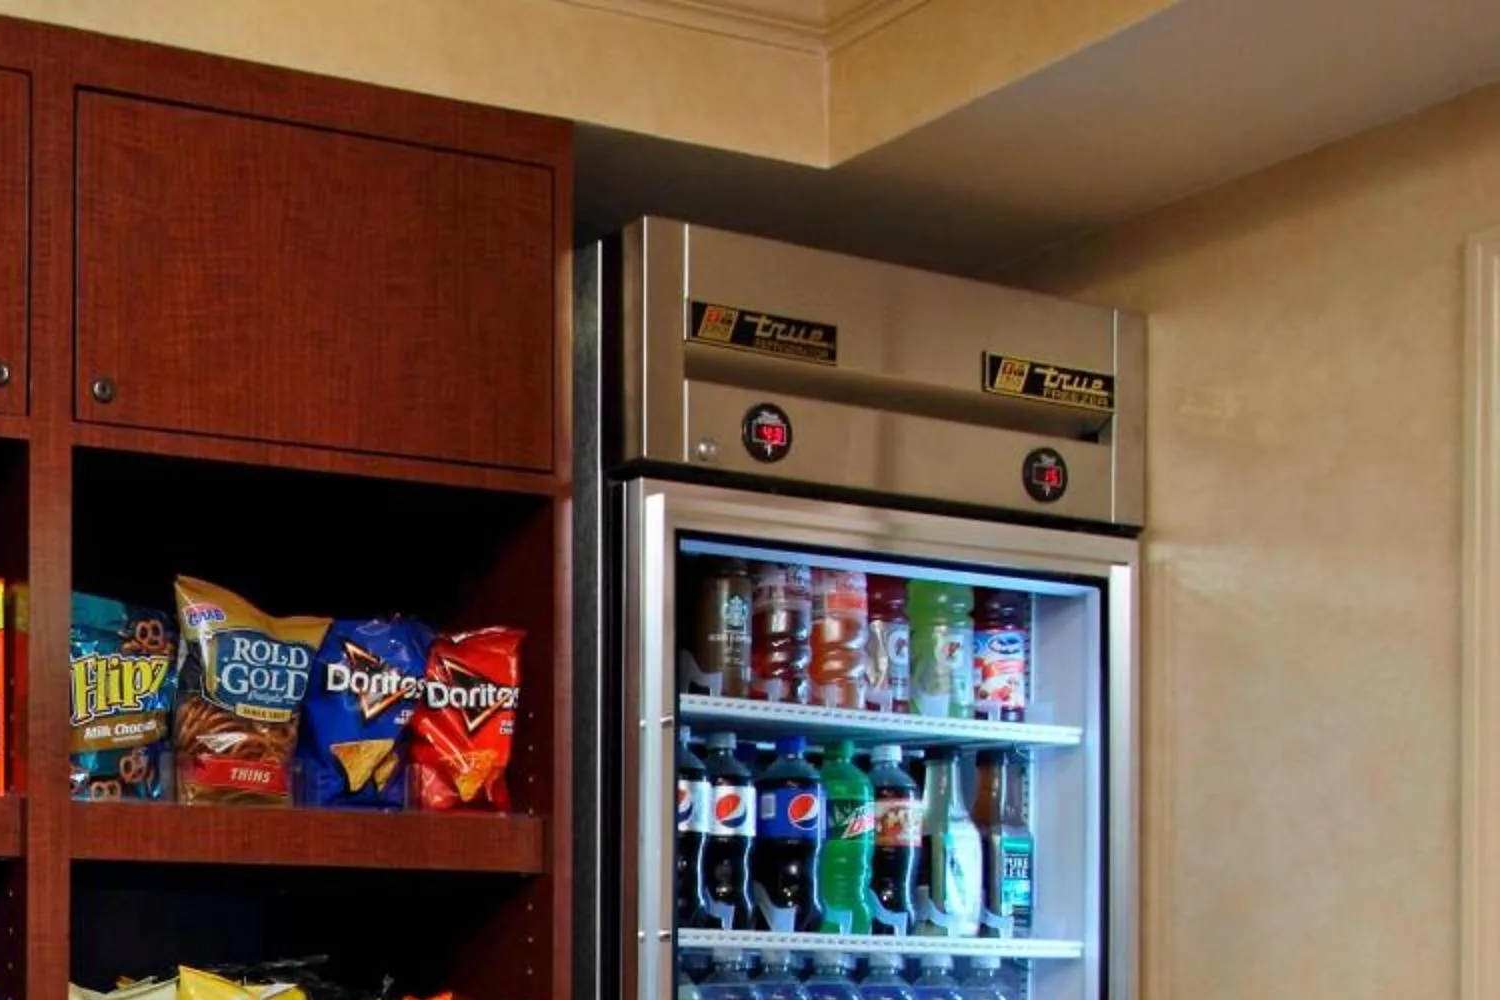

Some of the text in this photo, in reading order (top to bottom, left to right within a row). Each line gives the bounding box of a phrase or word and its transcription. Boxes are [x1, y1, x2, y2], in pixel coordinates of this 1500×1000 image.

[233, 637, 309, 669] ROLD
[221, 663, 309, 701] GOLD
[326, 662, 426, 699] Doritos
[427, 681, 520, 708] Doritos
[84, 724, 111, 741] Milk
[230, 767, 272, 784] THINS
[1004, 856, 1029, 868] PURE
